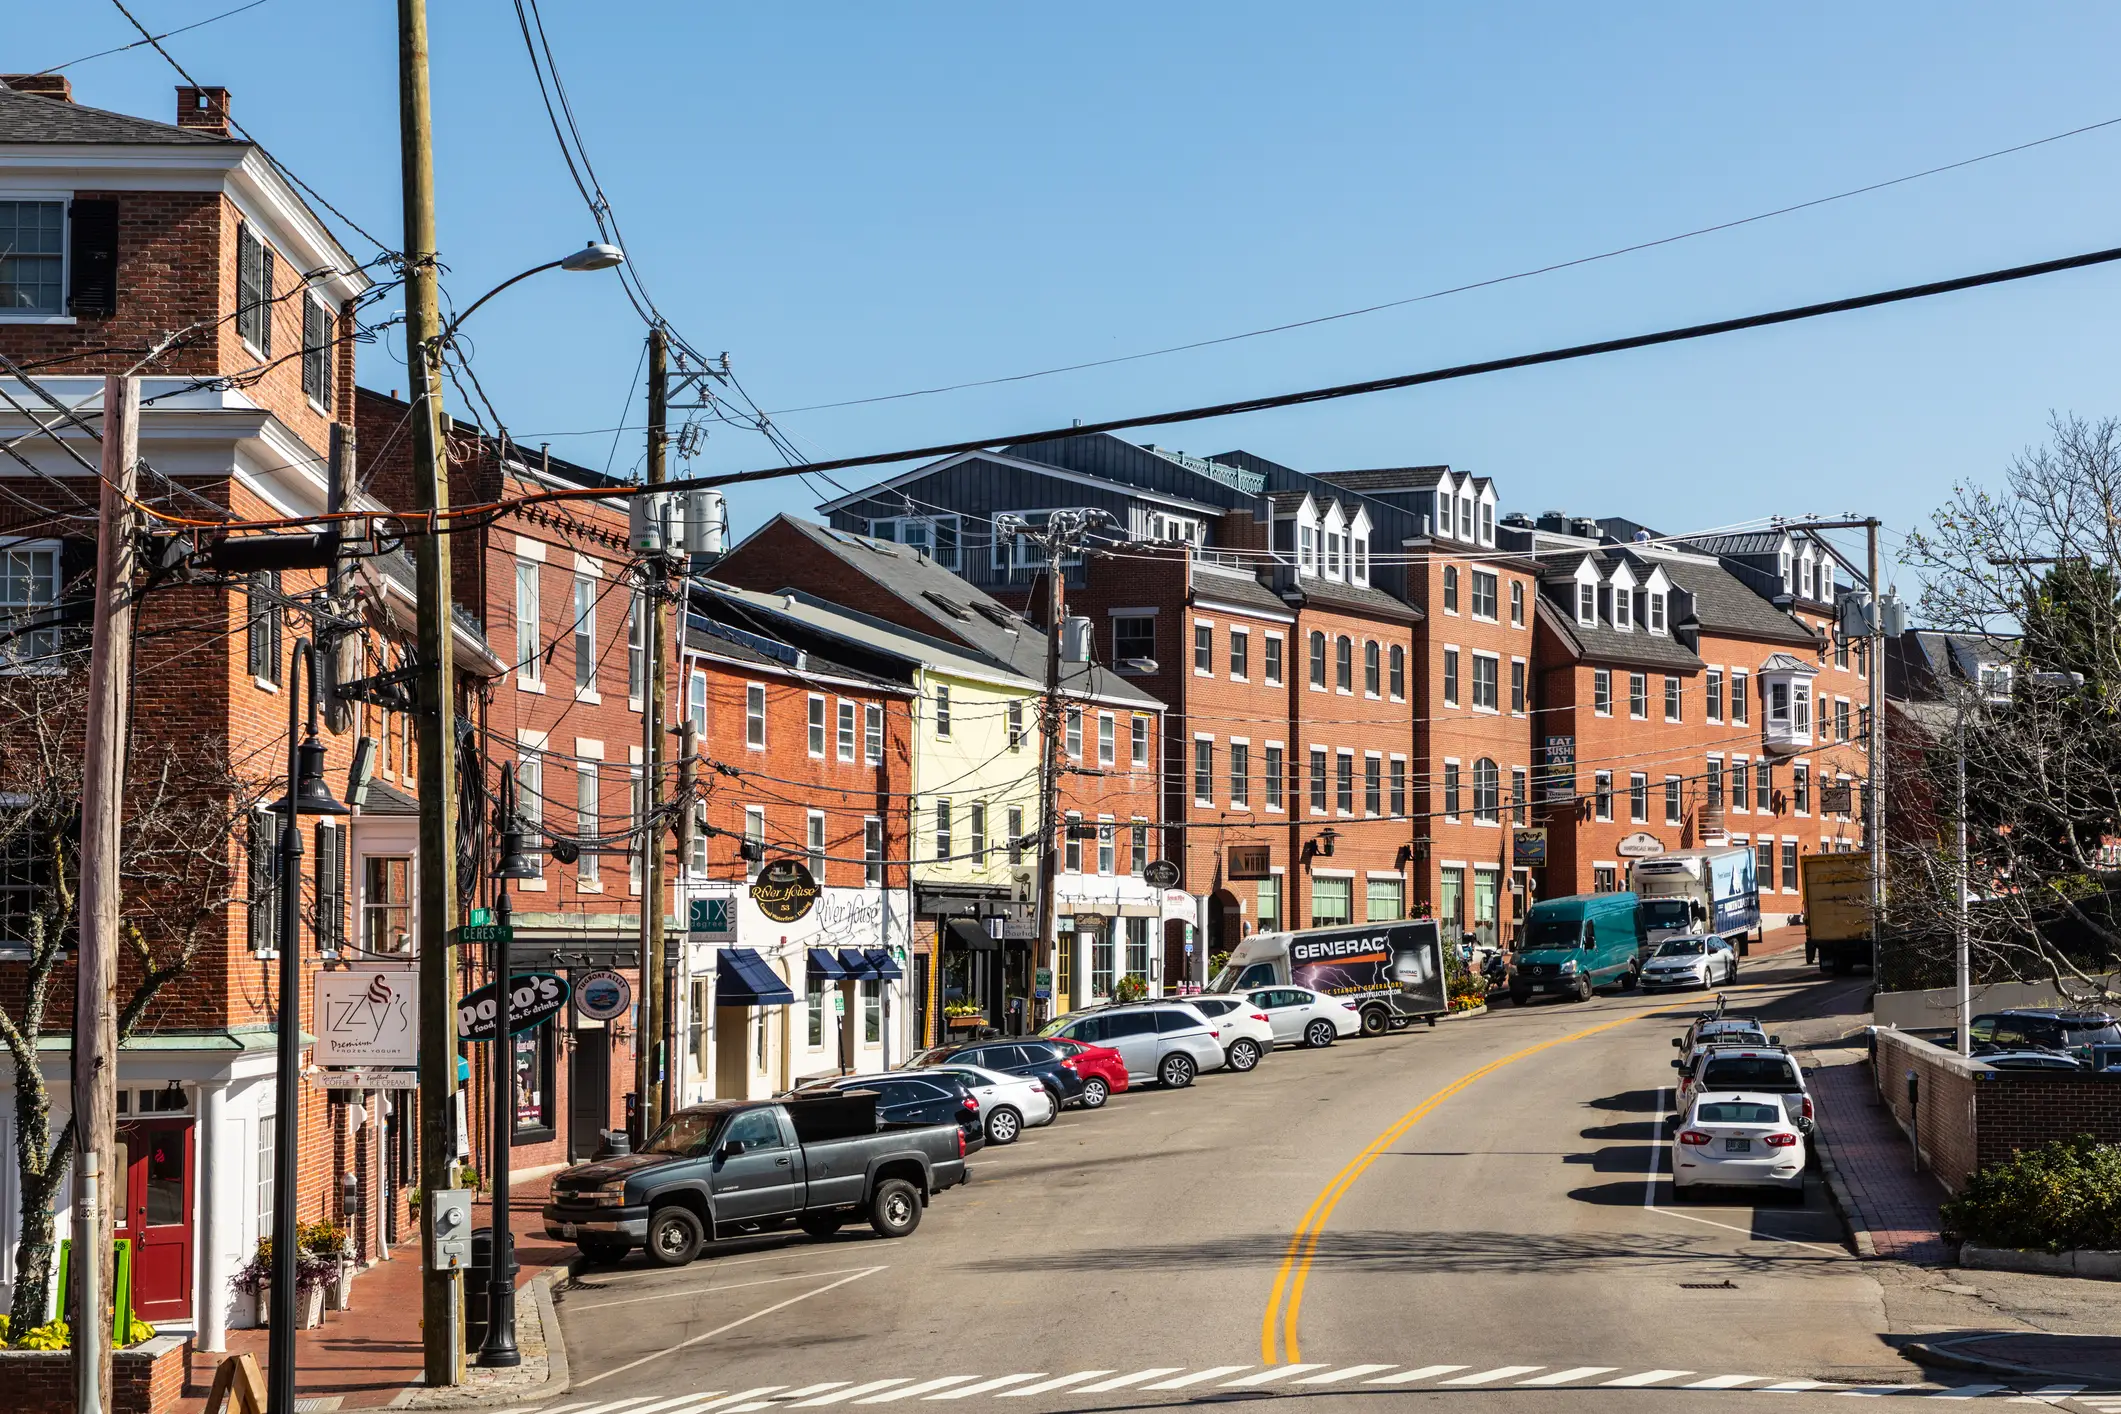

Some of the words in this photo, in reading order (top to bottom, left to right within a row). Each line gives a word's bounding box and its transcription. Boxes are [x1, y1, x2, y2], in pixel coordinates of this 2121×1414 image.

[1549, 737, 1572, 746] EAT
[1552, 756, 1569, 764] AT
[1518, 831, 1543, 844] Surf
[751, 884, 782, 902] River
[784, 883, 820, 901] House
[815, 892, 846, 934] River
[847, 893, 881, 934] House
[463, 927, 495, 940] CERES
[1294, 937, 1386, 959] GENERAC
[577, 972, 606, 991] TUGBOAT
[606, 974, 626, 989] ALLEY
[523, 1008, 532, 1017] &
[532, 1000, 560, 1014] drinks
[330, 1039, 372, 1052] Premium
